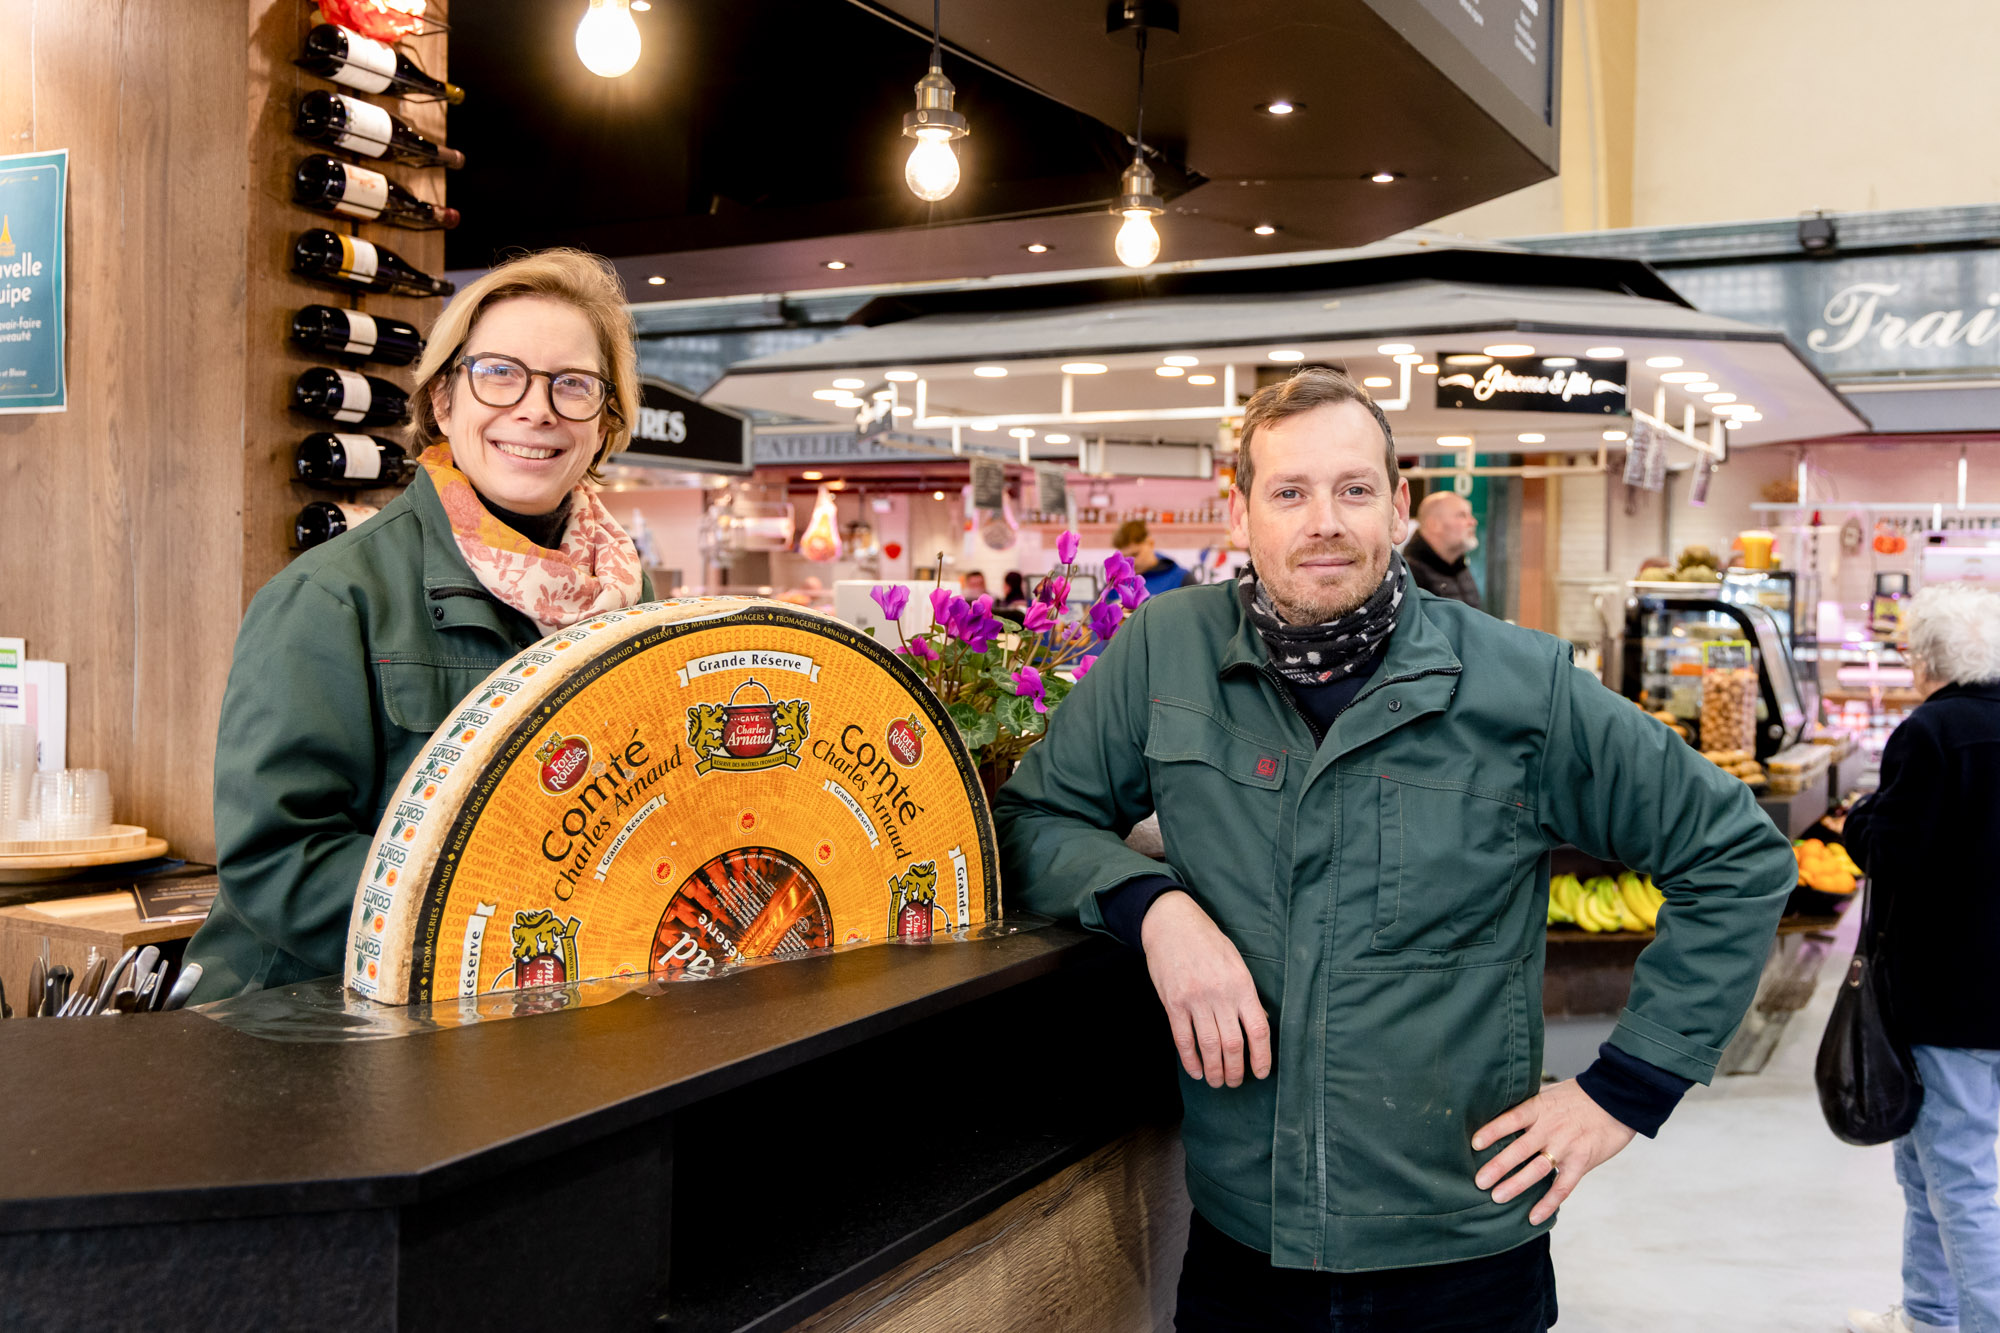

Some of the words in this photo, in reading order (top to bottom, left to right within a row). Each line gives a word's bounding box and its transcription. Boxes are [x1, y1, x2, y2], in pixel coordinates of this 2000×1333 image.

[0, 252, 42, 279] velle
[698, 655, 746, 672] Grande
[751, 653, 802, 670] Réserve
[726, 729, 774, 747] Arnaud
[736, 724, 766, 735] Charles
[740, 715, 760, 723] CAVE
[899, 728, 915, 749] Fort
[550, 748, 573, 774] Fort
[889, 728, 915, 763] Rousses
[549, 749, 588, 790] Rousses
[841, 724, 925, 826] Comté
[423, 907, 439, 973] FROMAGERIES
[436, 864, 453, 905] ARNAUD
[453, 814, 475, 851] RESERVE
[471, 795, 484, 812] DES
[481, 758, 508, 795] MAÎTRES
[505, 714, 544, 758] FROMAGERS
[552, 665, 601, 707] FROMAGERIES
[602, 646, 633, 668] ARNAUD
[643, 628, 674, 646] RESERVE
[675, 623, 689, 634] DES
[723, 613, 765, 623] FROMAGERS
[776, 615, 821, 631] FROMAGERIES
[822, 626, 849, 642] ARNAUD
[856, 641, 880, 661] RESERVE
[880, 657, 891, 669] DES
[542, 729, 650, 862] Comté
[812, 740, 869, 792] Charles
[866, 793, 912, 861] Arnaud
[834, 786, 855, 808] Grande
[854, 807, 874, 836] Réserve
[554, 815, 611, 902] Charles
[614, 743, 684, 816] Arnaud
[602, 833, 627, 866] Grande
[625, 802, 656, 834] Réserve
[957, 866, 967, 917] Grande
